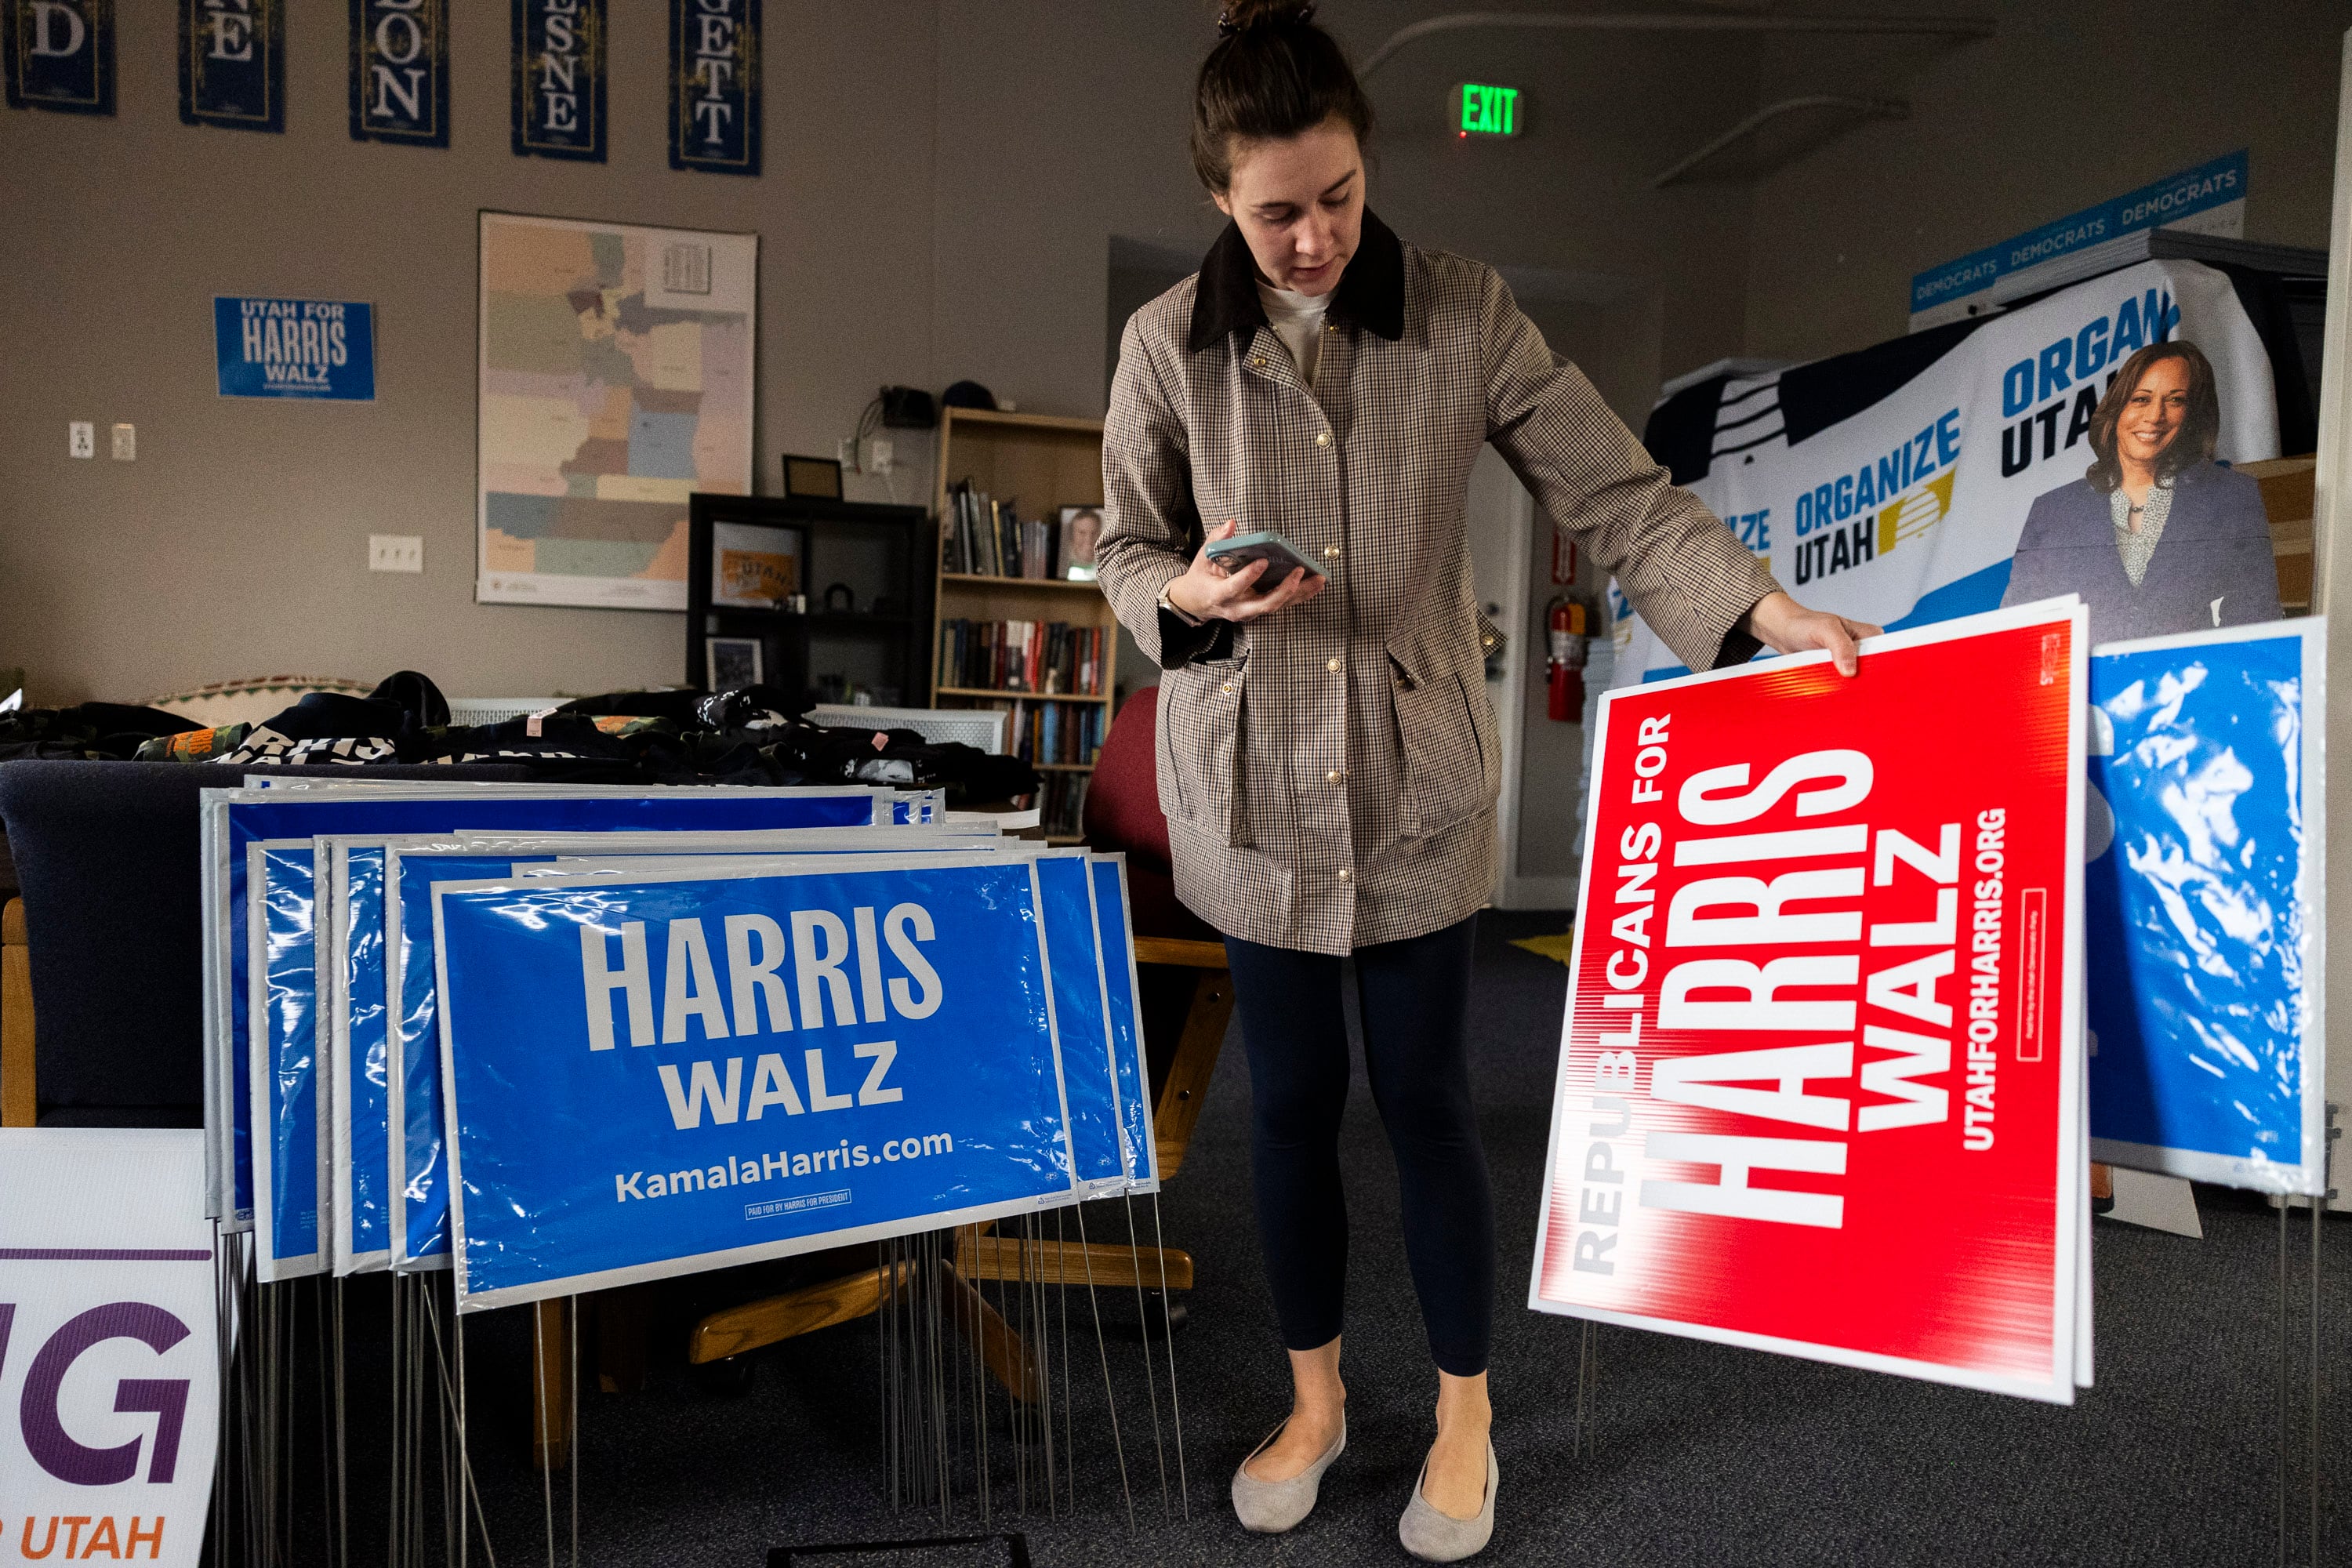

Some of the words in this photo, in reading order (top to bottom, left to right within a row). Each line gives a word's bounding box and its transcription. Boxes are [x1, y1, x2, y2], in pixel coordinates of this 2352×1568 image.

[371, 0, 426, 121] ON
[1462, 84, 1518, 134] EXIT
[1917, 259, 1998, 301] DEMOCRATS
[2011, 219, 2106, 267] DEMOCRATS
[2122, 169, 2238, 225] DEMOCRATS
[241, 299, 297, 318] UTAH
[303, 303, 345, 320] FOR
[242, 317, 348, 367] HARRIS
[264, 364, 329, 383] WALZ
[2002, 369, 2118, 477] UTA
[1795, 406, 1961, 537] ORGANIZE
[1795, 515, 1874, 586] UTAH
[579, 902, 943, 1052] HARRIS
[1573, 822, 1662, 1276] REPUBLICANS
[1632, 713, 1671, 803] FOR
[1639, 749, 1875, 1229] HARRIS
[1857, 822, 1962, 1132] WALZ
[1963, 808, 2007, 1152] UTAHFORHARRIS.ORG
[657, 1040, 904, 1131] WALZ
[615, 1131, 954, 1203] KamalaHarris.com
[748, 1207, 762, 1217] PAID
[763, 1206, 775, 1214] FOR
[784, 1200, 806, 1210] HARRIS
[807, 1198, 818, 1207] FOR
[818, 1192, 848, 1205] PRESIDENT
[21, 1516, 165, 1560] UTAH
